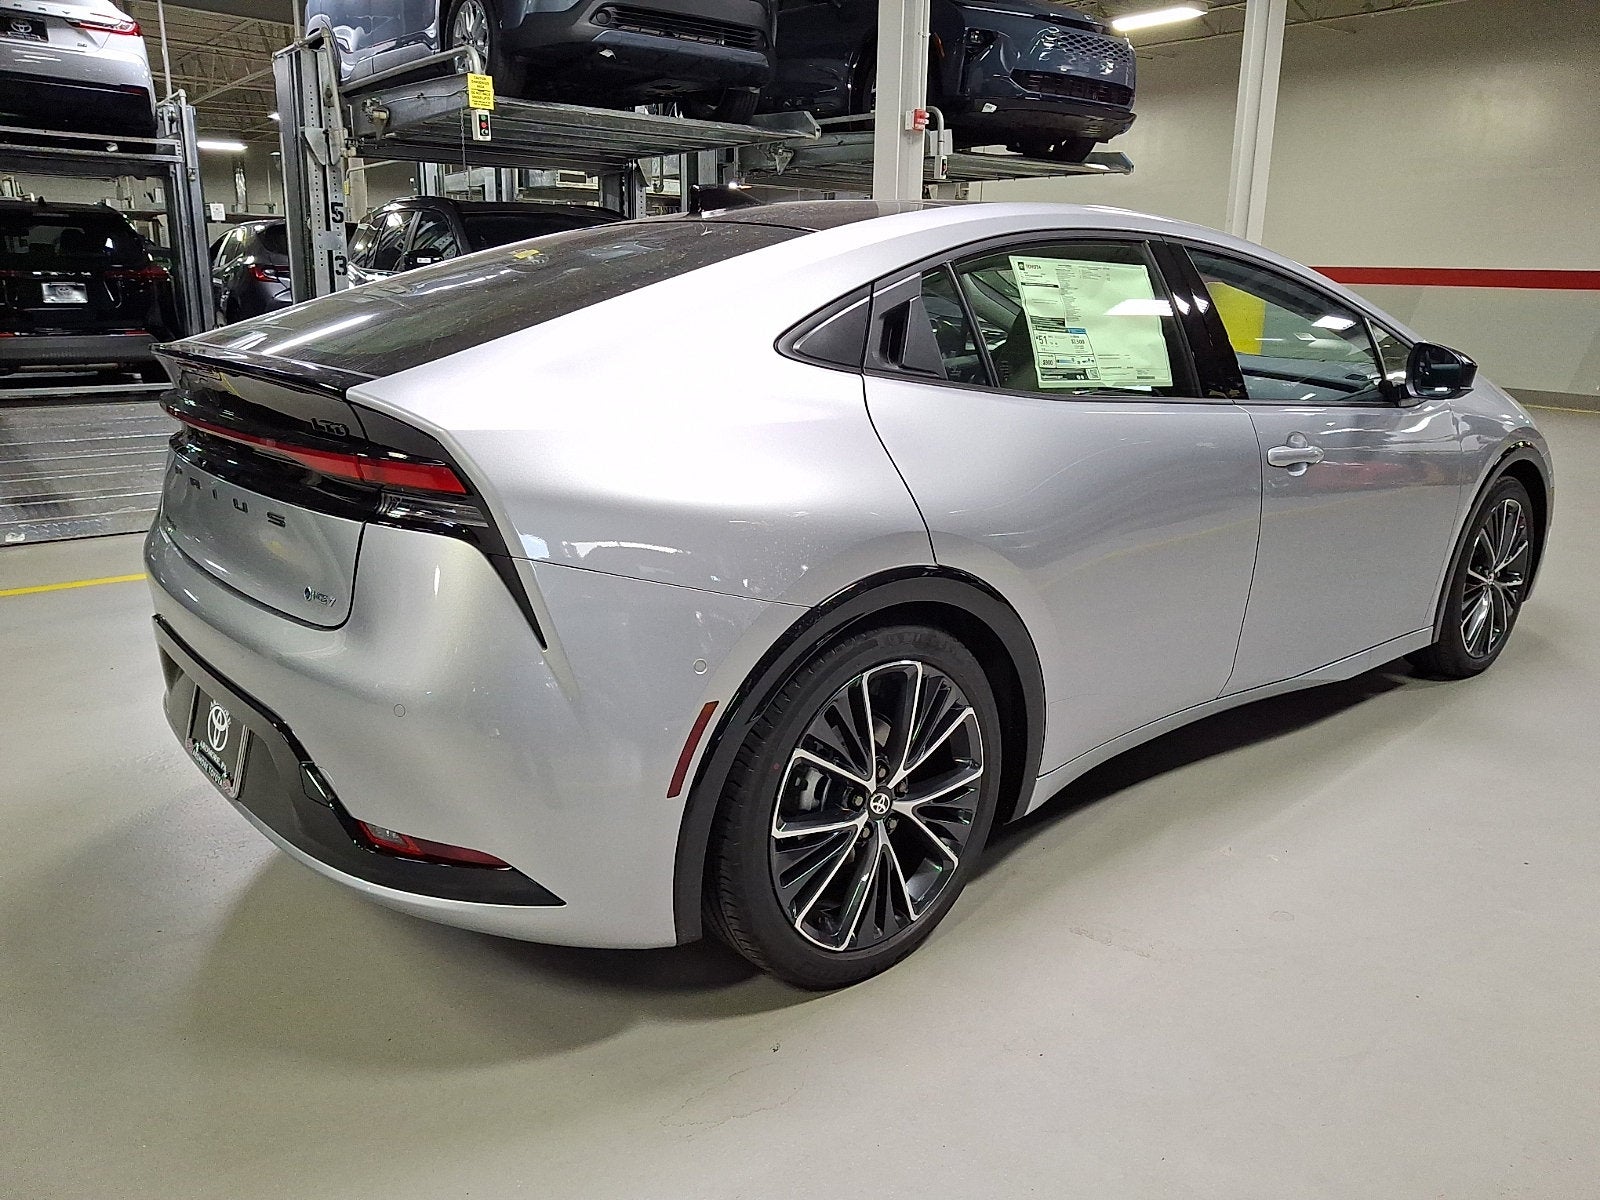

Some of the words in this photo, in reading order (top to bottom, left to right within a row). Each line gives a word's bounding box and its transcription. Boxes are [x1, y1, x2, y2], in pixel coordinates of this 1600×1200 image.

[330, 201, 345, 224] 5
[334, 255, 348, 276] 3
[1038, 335, 1048, 345] 51
[310, 417, 350, 438] LTD
[174, 464, 286, 528] PRIUS
